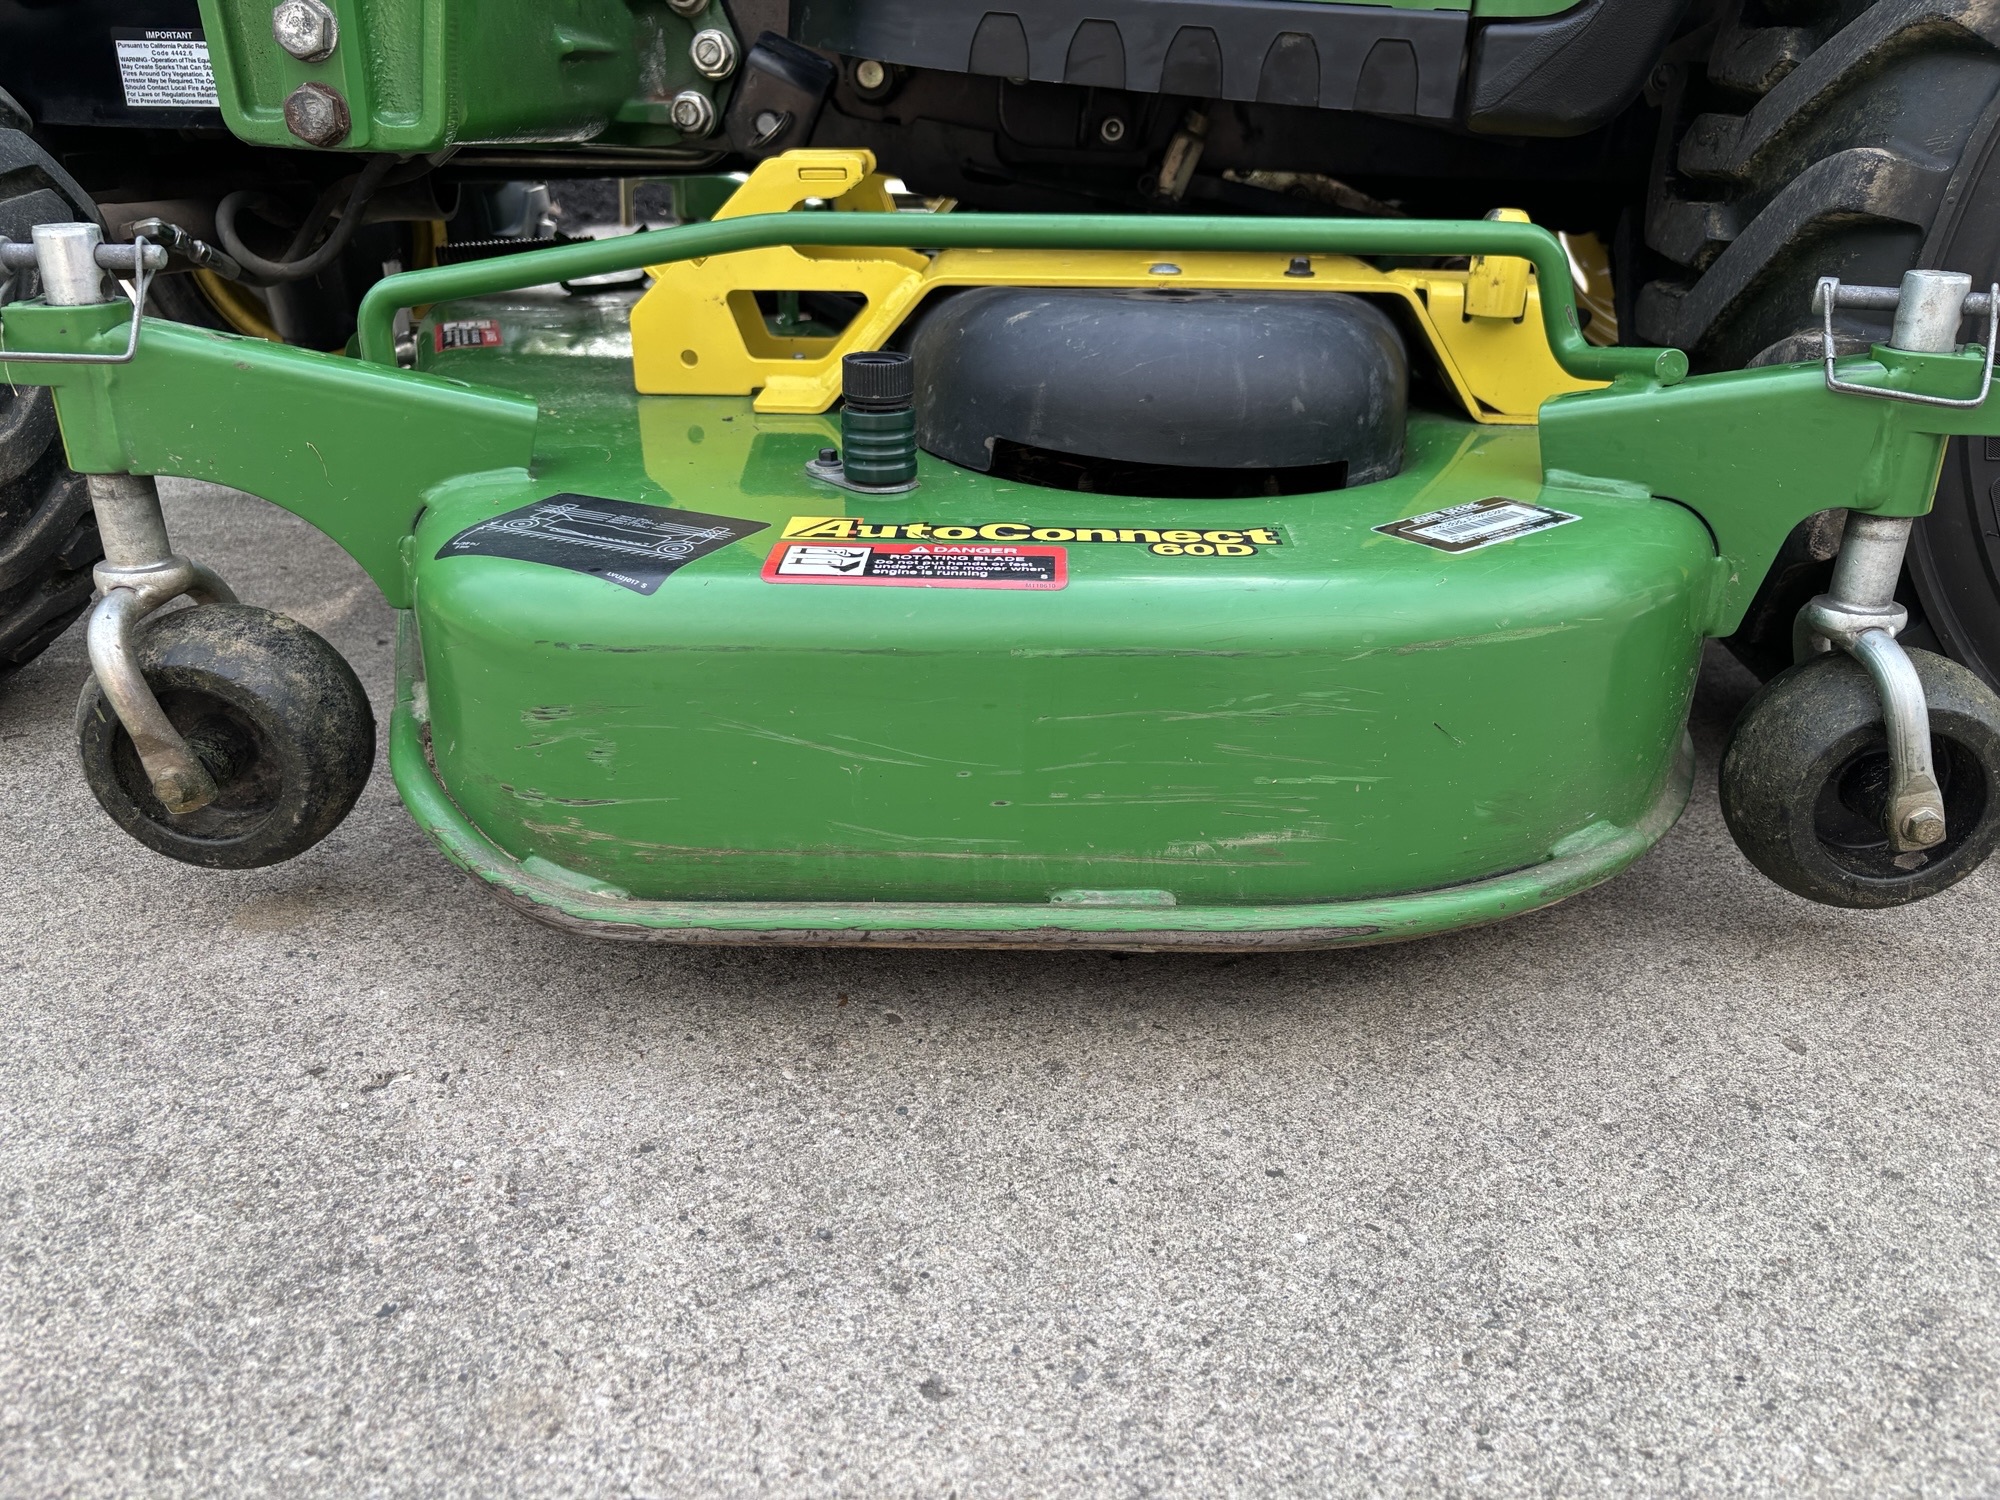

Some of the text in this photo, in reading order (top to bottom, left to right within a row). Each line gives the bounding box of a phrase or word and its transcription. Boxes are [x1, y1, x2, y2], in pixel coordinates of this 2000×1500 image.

[145, 31, 192, 39] IMPORTANT
[785, 518, 1278, 545] AutoConnect
[933, 546, 1018, 554] DANGER
[1150, 542, 1256, 556] 60D
[936, 570, 989, 578] running
